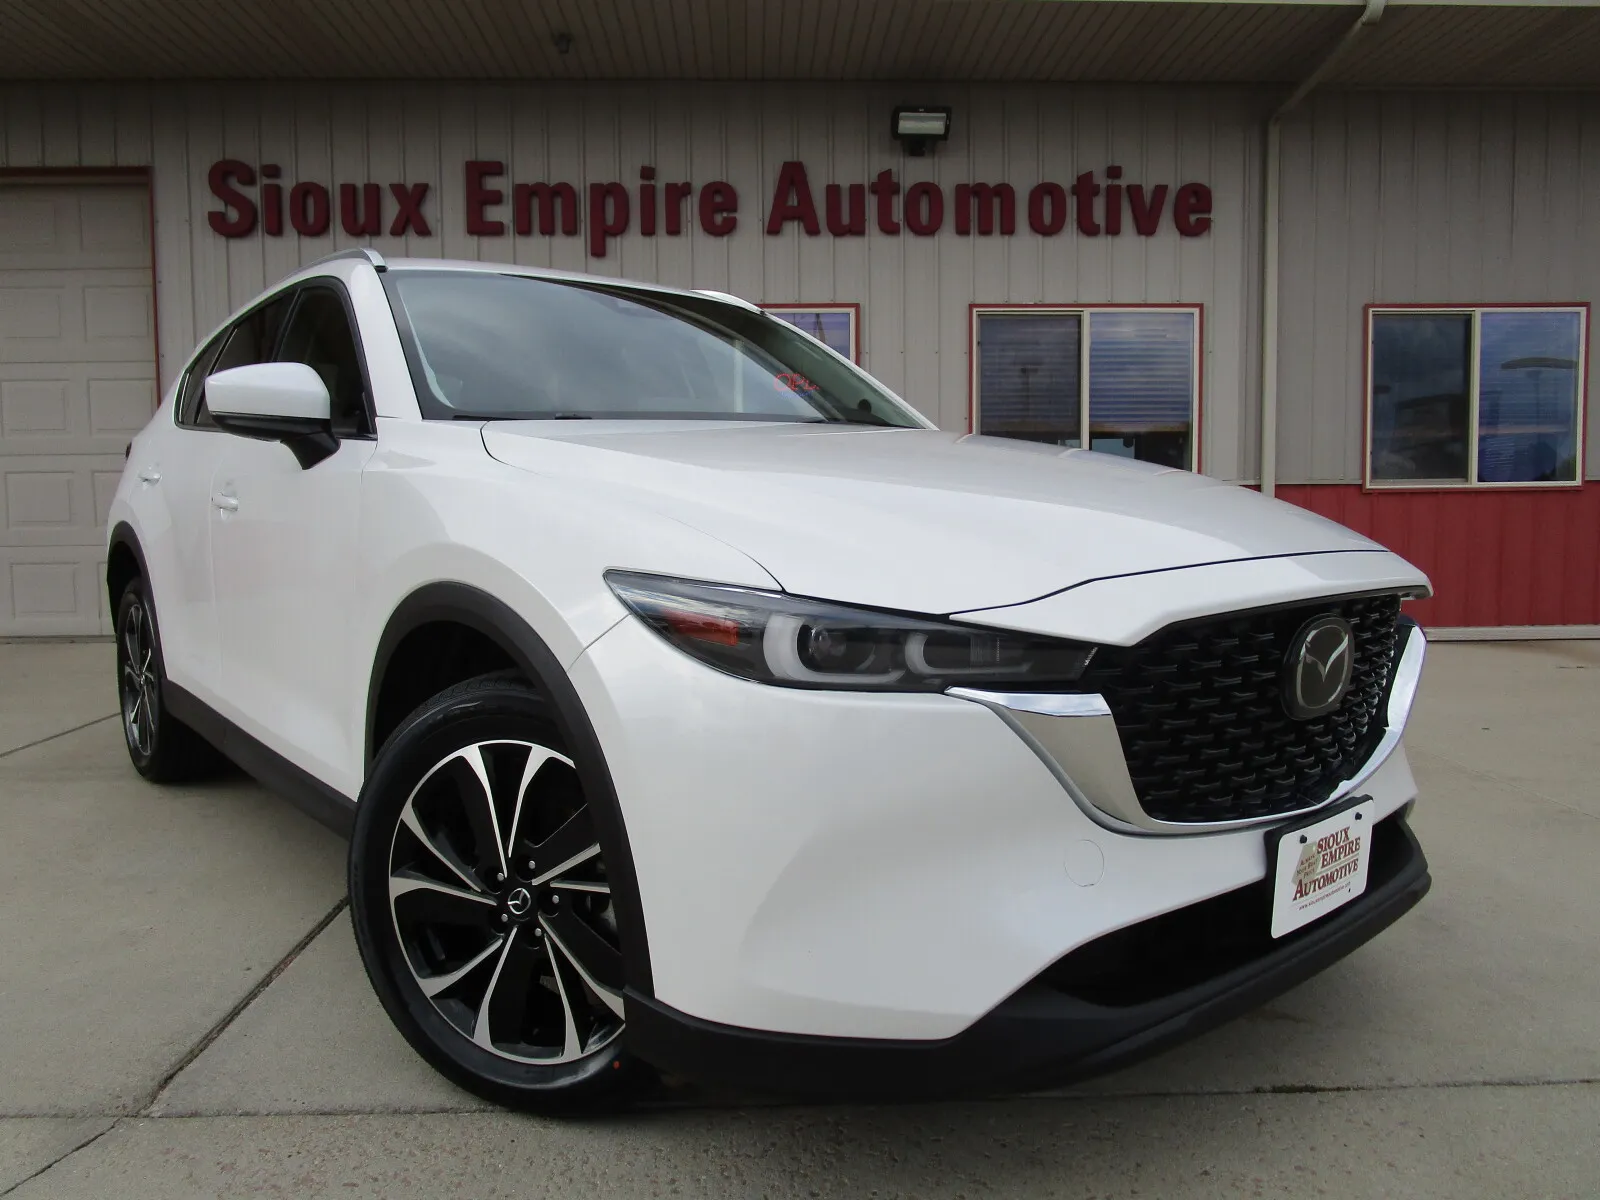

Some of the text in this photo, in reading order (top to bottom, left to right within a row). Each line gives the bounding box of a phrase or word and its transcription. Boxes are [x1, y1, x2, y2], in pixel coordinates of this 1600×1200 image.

[208, 160, 1212, 257] Sioux Empire Automotive
[1317, 826, 1350, 854] SIOUX
[1321, 836, 1361, 869] EMPIRE
[1293, 858, 1359, 902] AUTOMOTIVE
